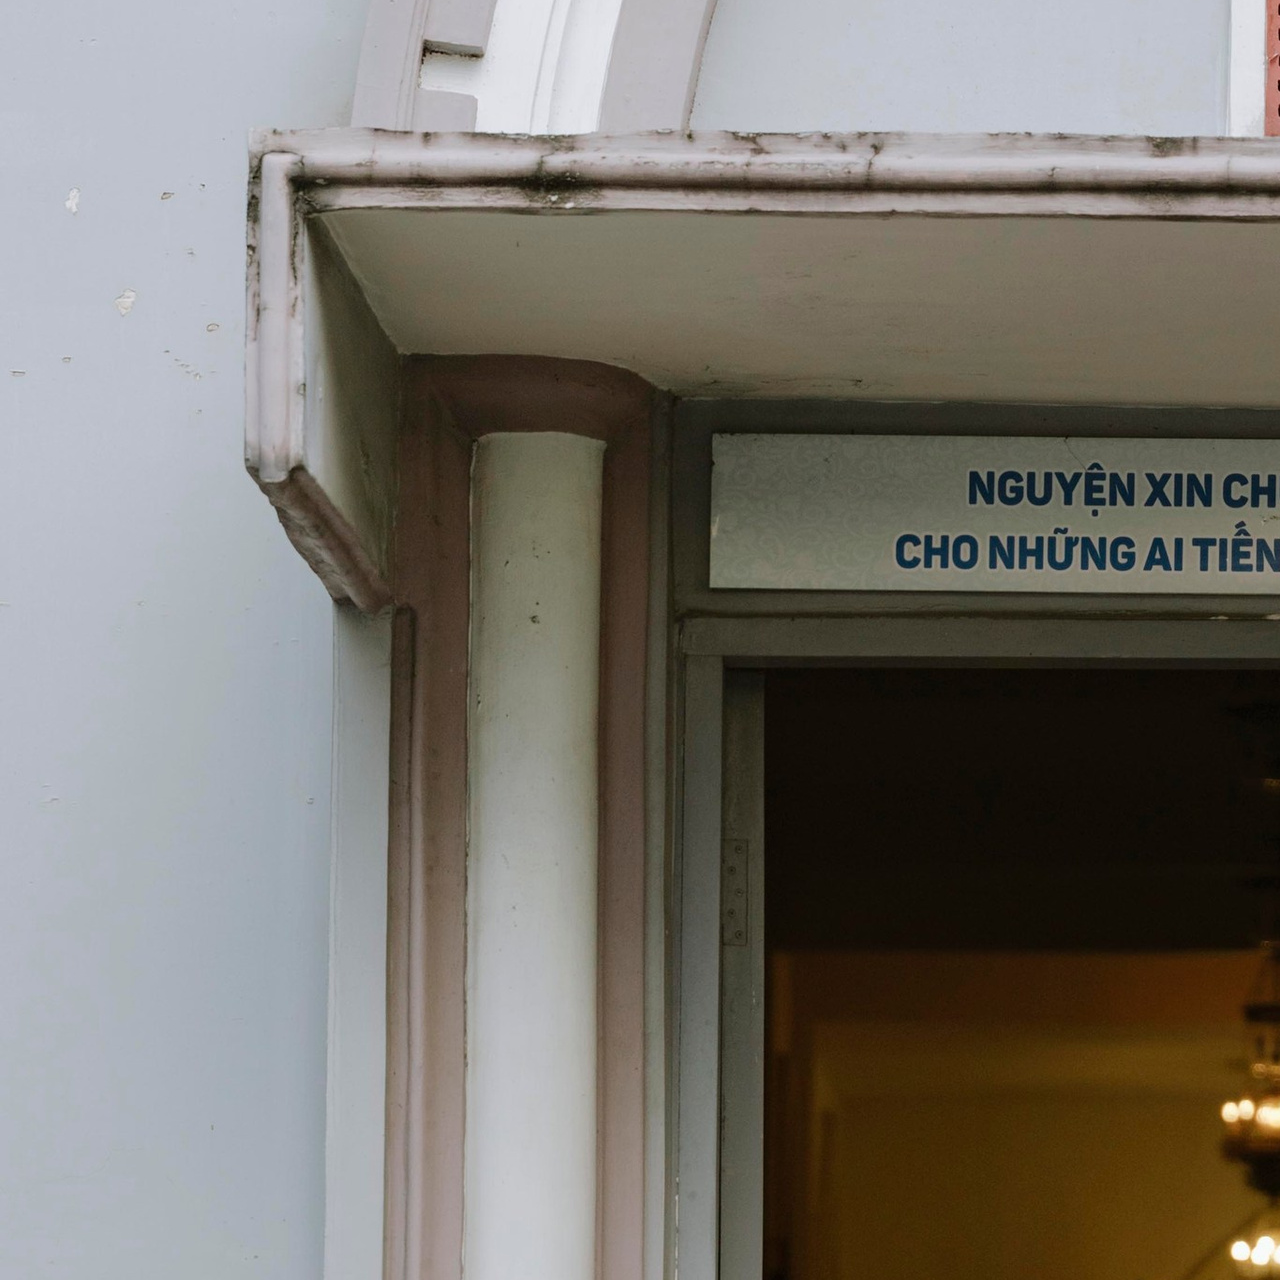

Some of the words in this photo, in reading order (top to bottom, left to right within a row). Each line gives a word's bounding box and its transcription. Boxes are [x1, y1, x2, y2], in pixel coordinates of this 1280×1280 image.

[969, 462, 1135, 517] NGUYỆN
[1144, 472, 1213, 507] XIN
[895, 534, 979, 569] CHO
[989, 527, 1136, 571] NHỮNG
[1143, 537, 1183, 571] AI
